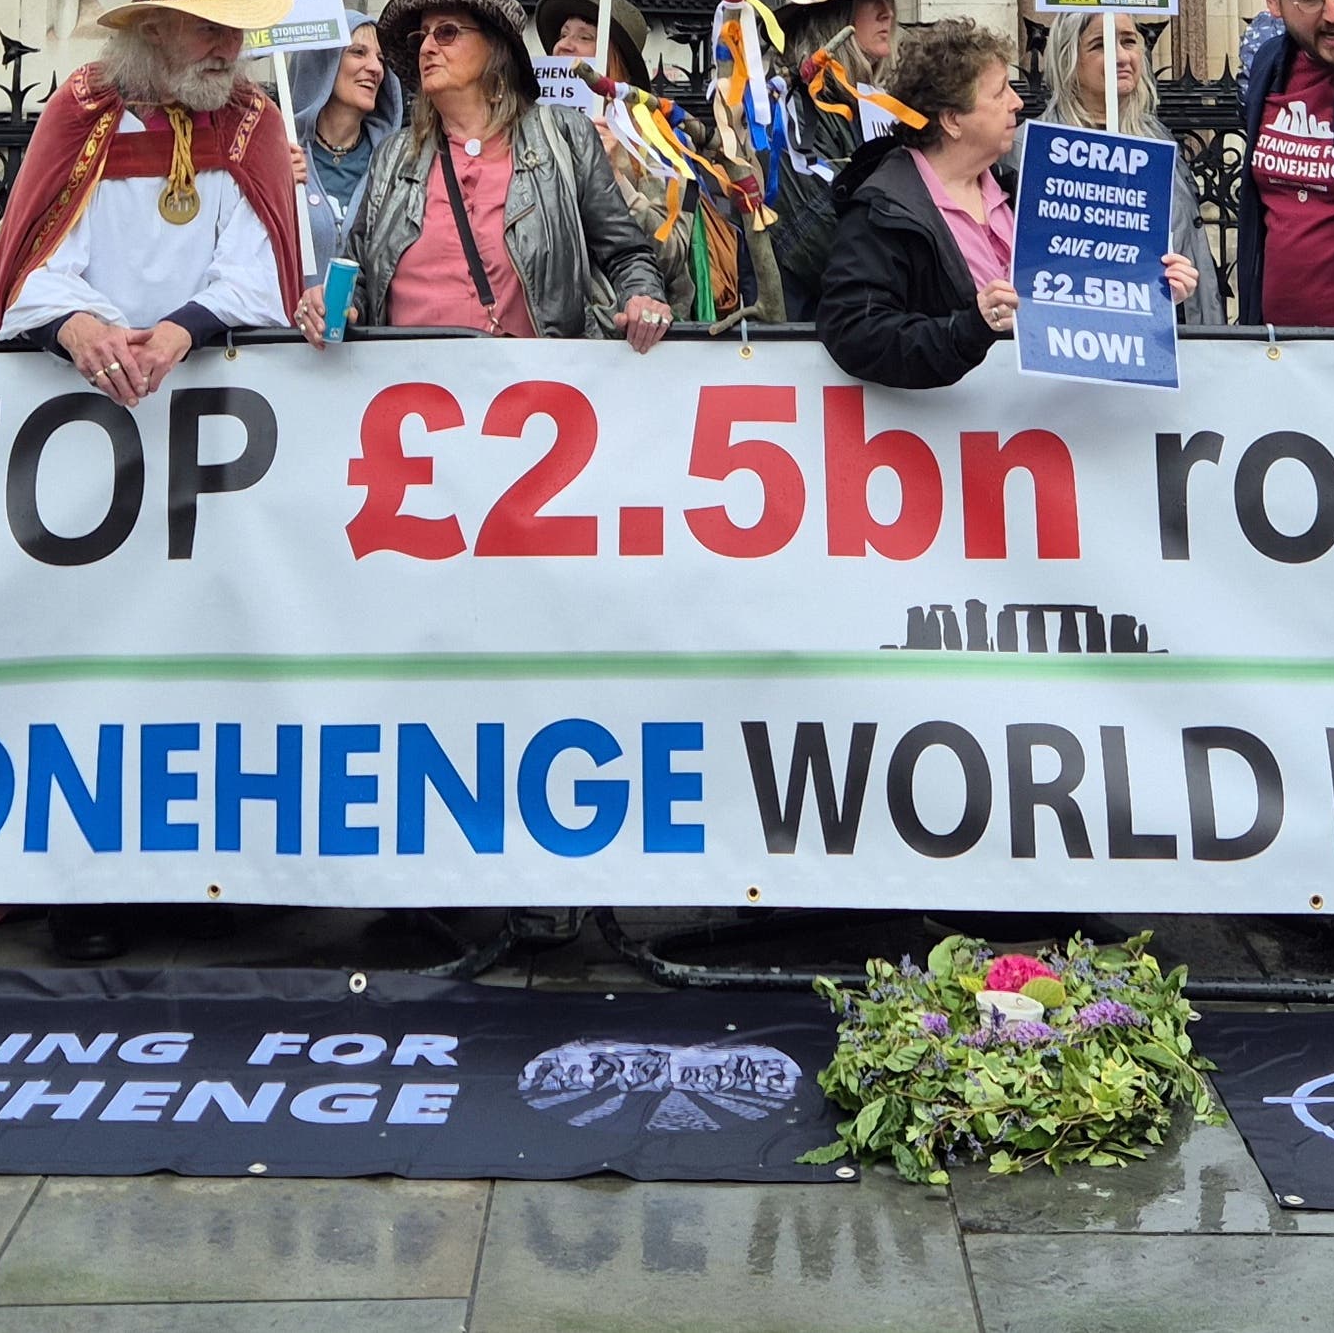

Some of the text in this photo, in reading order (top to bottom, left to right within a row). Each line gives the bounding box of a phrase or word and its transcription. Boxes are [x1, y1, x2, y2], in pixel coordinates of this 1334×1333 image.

[272, 23, 329, 38] STONEHENGE
[561, 87, 574, 99] IS
[1049, 137, 1148, 175] SCRAP
[1257, 134, 1321, 158] STANDING
[1045, 177, 1147, 208] STONEHENGE
[1038, 200, 1150, 232] ROAD SCHEME
[1048, 236, 1139, 264] SAVE OVER
[1033, 270, 1151, 312] £2.5BN
[1047, 326, 1146, 366] NOW!
[345, 381, 1081, 561] £2.5bn
[741, 720, 1284, 863] WORLD
[248, 1031, 459, 1067] FOR
